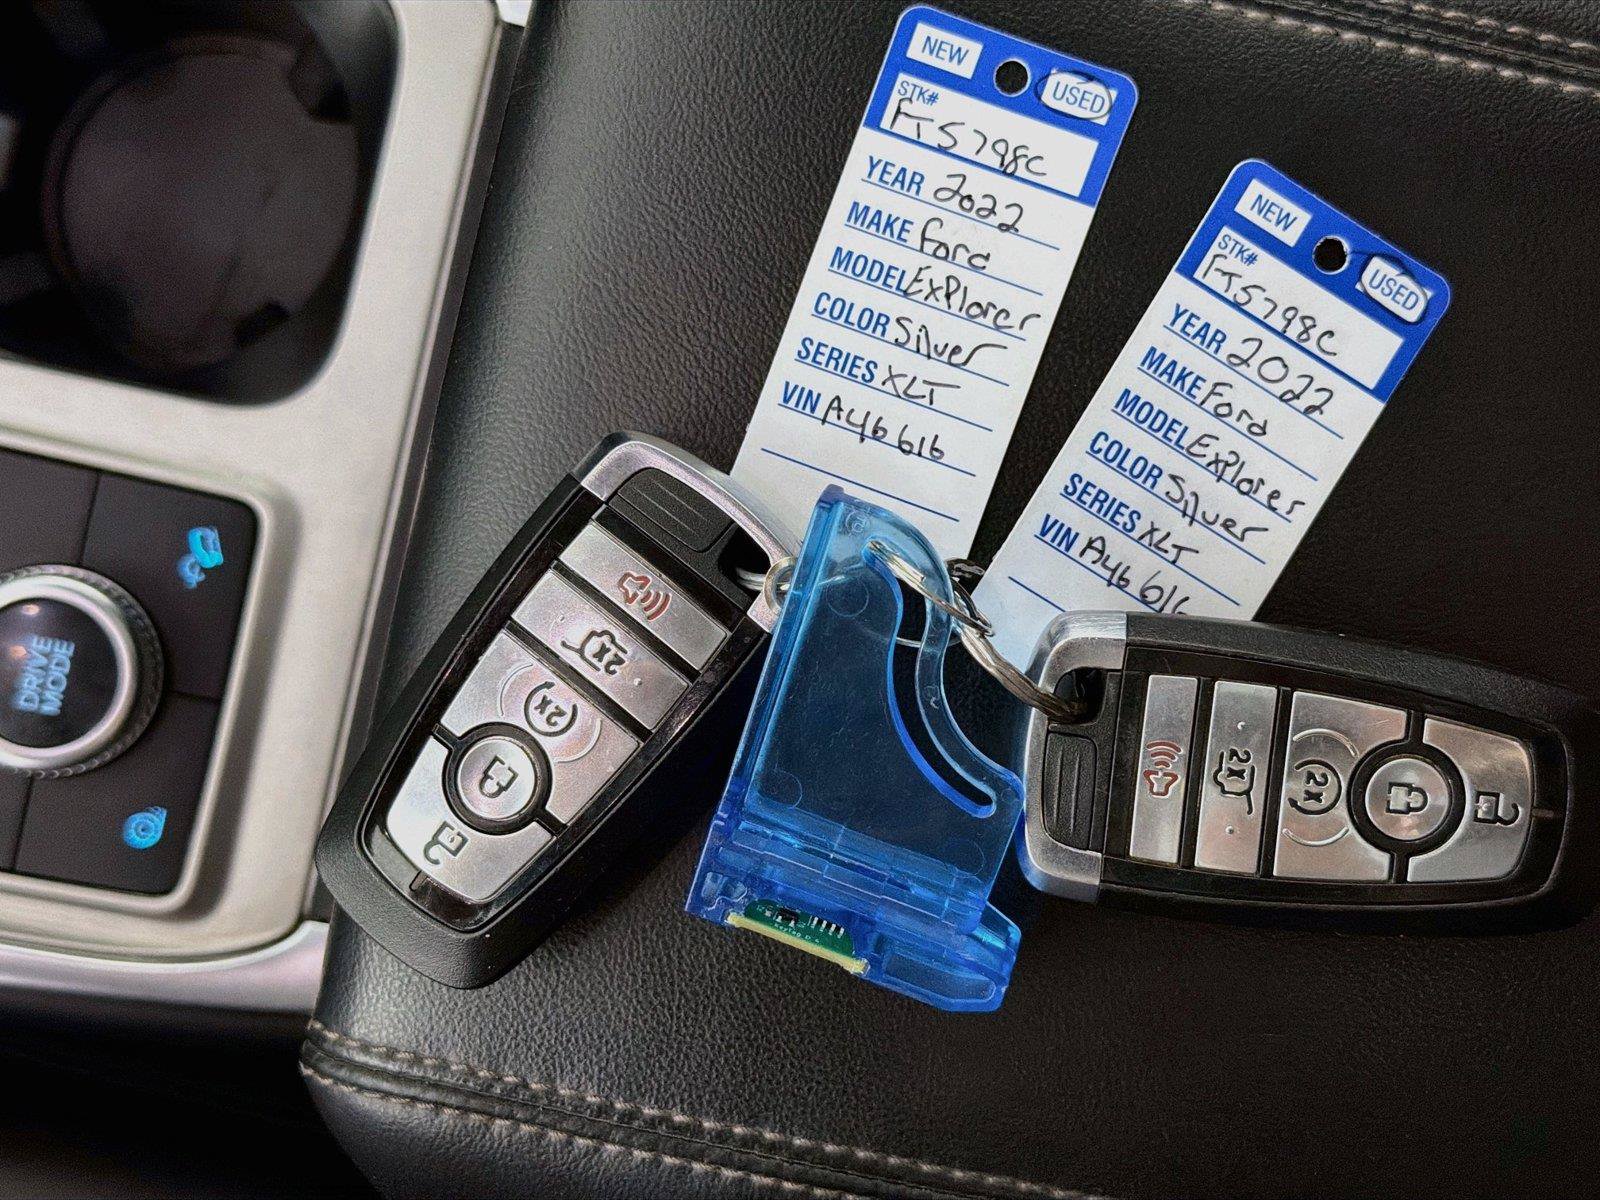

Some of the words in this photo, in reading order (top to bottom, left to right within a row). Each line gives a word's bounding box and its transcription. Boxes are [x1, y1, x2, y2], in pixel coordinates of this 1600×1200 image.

[921, 36, 969, 66] NEW
[898, 81, 940, 106] STK#
[1053, 82, 1107, 114] USED
[866, 155, 926, 196] YEAR
[934, 173, 1024, 234] 2022
[1250, 193, 1299, 233] NEW
[846, 201, 914, 244] MAKE
[829, 246, 907, 292] MODEL
[1218, 234, 1258, 267] STK#
[1368, 268, 1419, 312] USED
[813, 291, 891, 339] COLOR
[894, 316, 1008, 368] Silver
[797, 337, 878, 384] SERIES
[881, 365, 961, 406] XLT
[1140, 345, 1207, 400] MAKE
[1171, 303, 1227, 356] YEAR
[1226, 337, 1334, 416] 2022
[781, 381, 823, 416] VIN
[1113, 388, 1191, 451] MODEL
[1089, 431, 1163, 490] COLOR
[1165, 473, 1269, 542] Silver
[1039, 513, 1080, 552] VIN
[1063, 473, 1142, 534] SERIES
[1139, 521, 1200, 566] XLT
[14, 636, 51, 711] DRIVE
[40, 638, 75, 716] MODE
